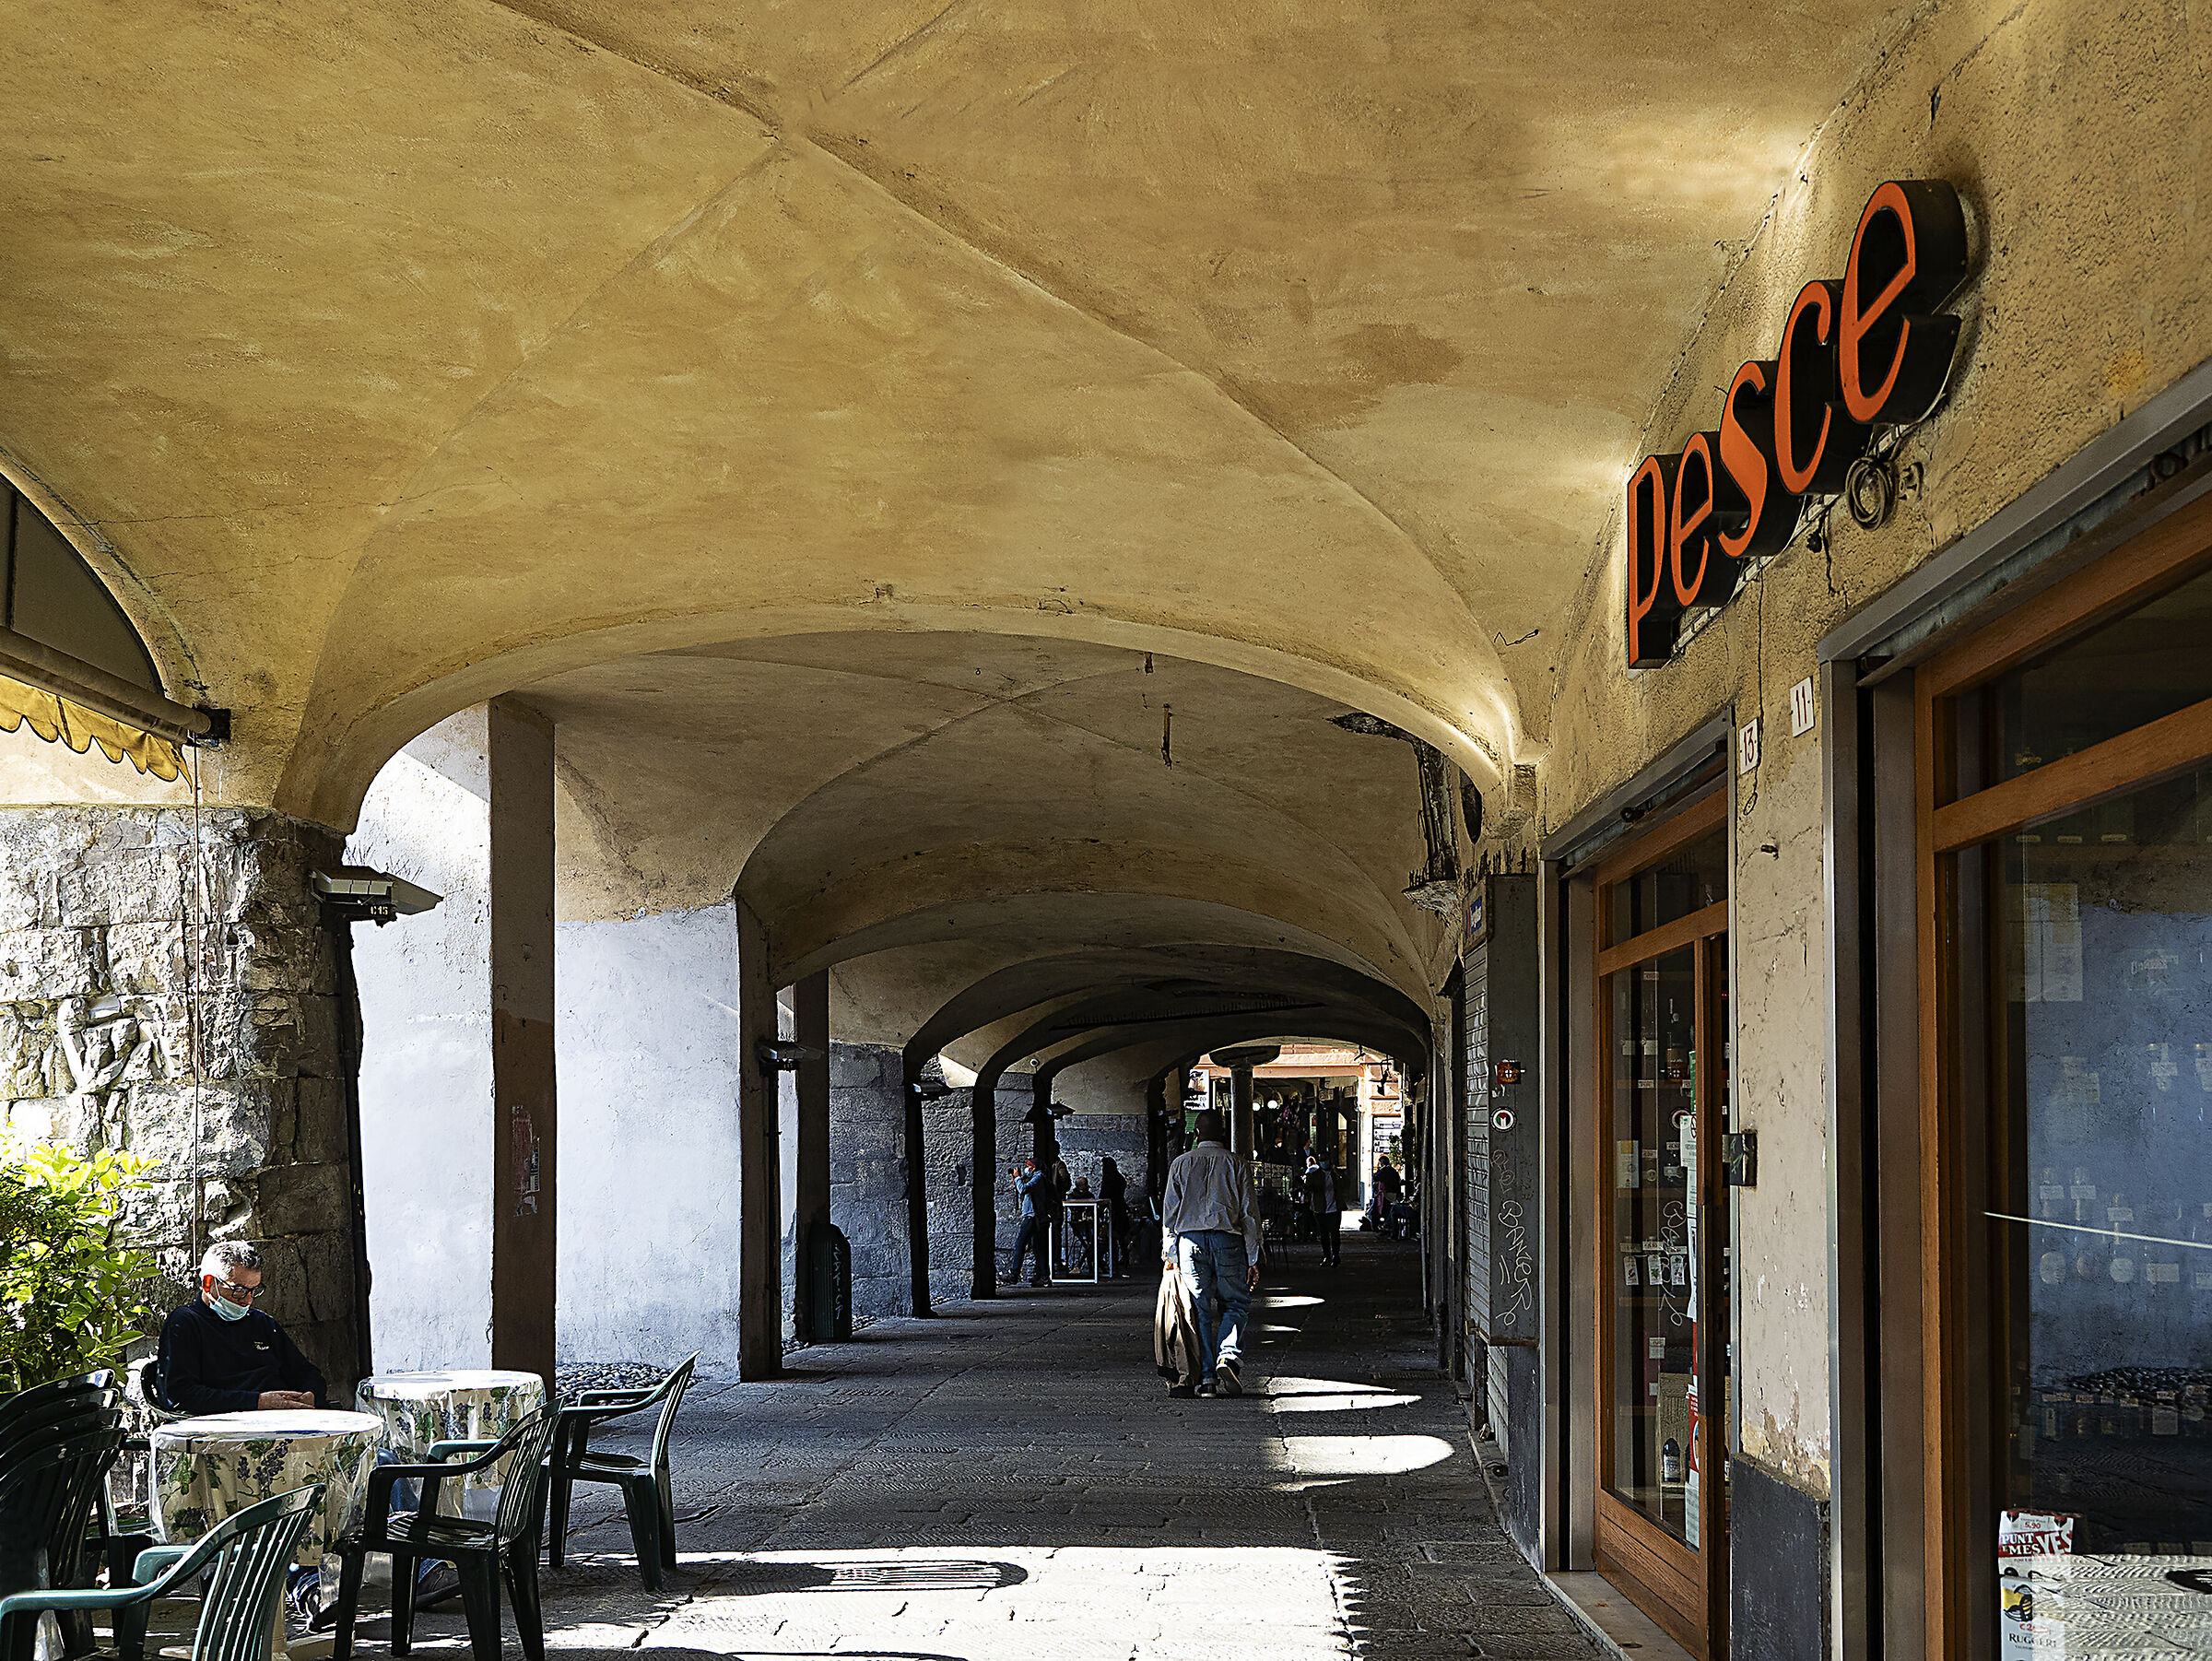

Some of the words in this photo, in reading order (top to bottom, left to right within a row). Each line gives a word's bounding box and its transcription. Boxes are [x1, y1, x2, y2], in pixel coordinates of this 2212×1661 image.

[1627, 180, 1917, 668] pesce
[1795, 685, 1807, 728] 11
[1743, 725, 1756, 767] 13
[2001, 1532, 2035, 1545] PUNT
[2009, 1543, 2041, 1556] MES
[2035, 1530, 2073, 1556] YES
